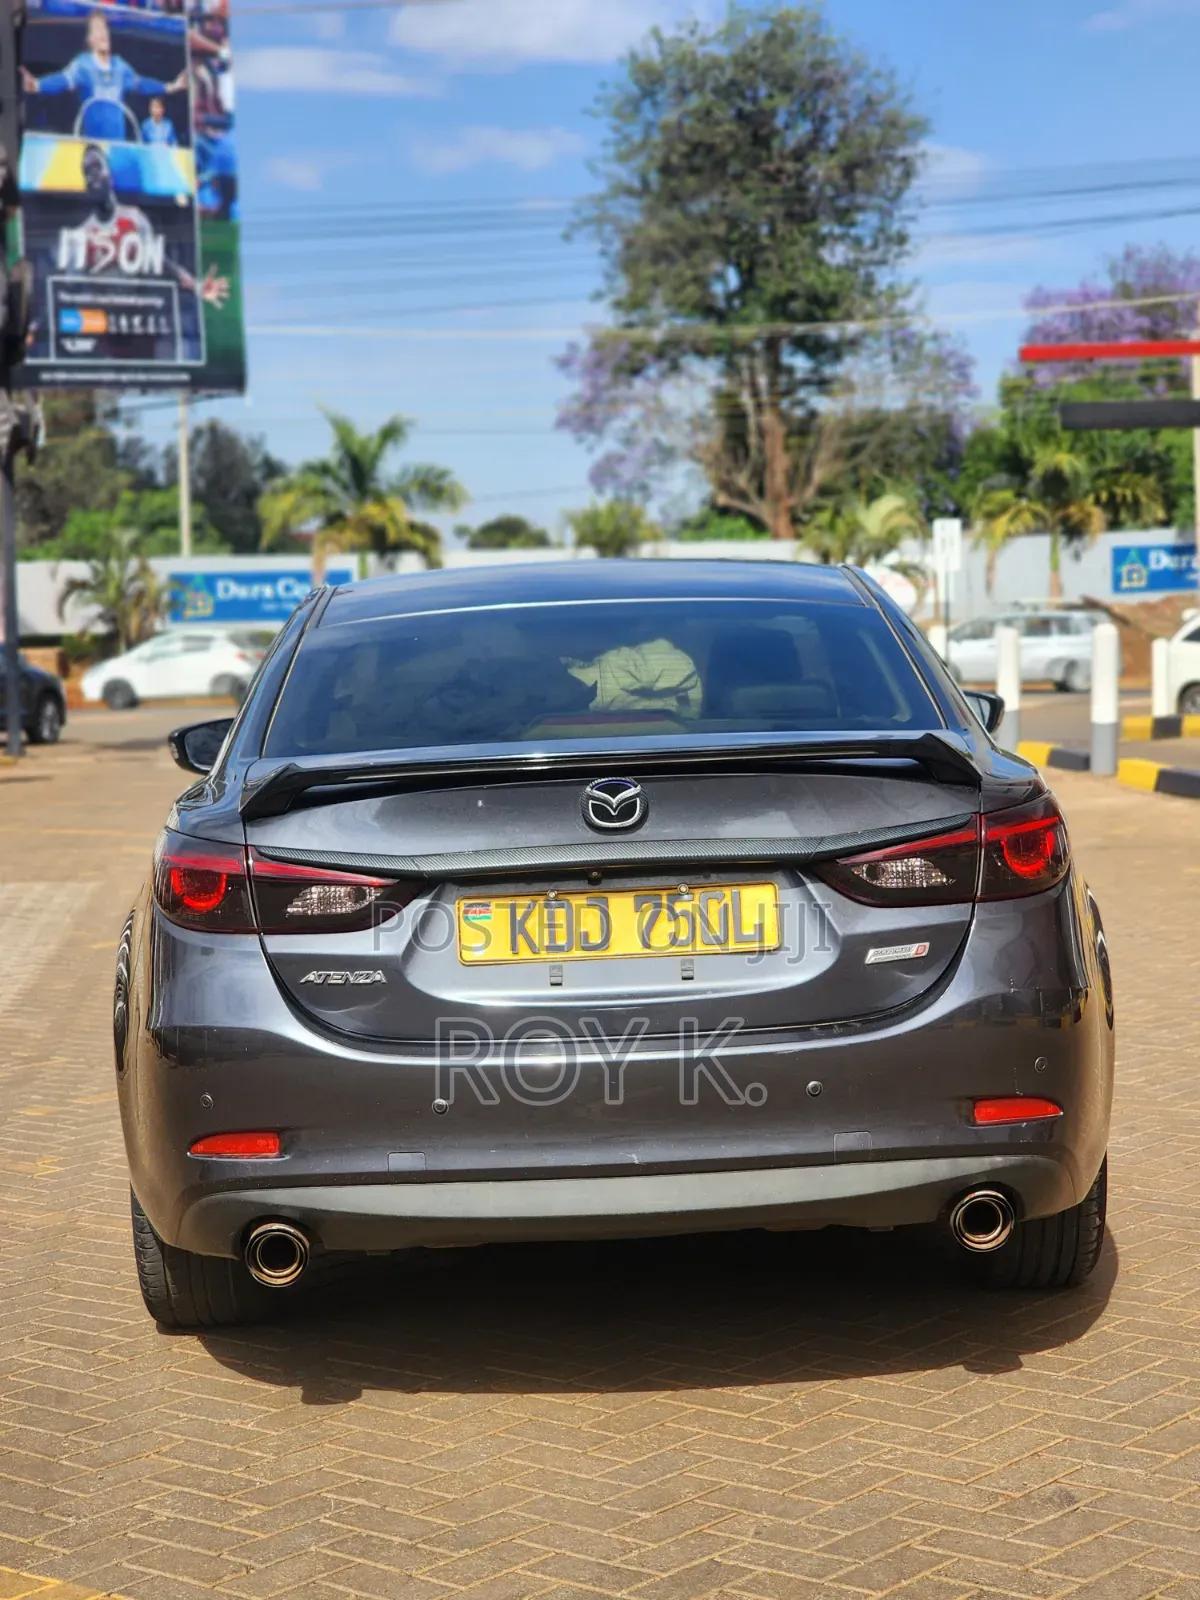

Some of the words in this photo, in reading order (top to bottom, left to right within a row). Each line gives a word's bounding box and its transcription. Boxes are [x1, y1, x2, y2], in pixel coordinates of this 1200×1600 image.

[118, 232, 164, 276] ON
[217, 578, 275, 600] Dura
[510, 896, 610, 955] KDJ
[299, 969, 387, 985] ATENZA
